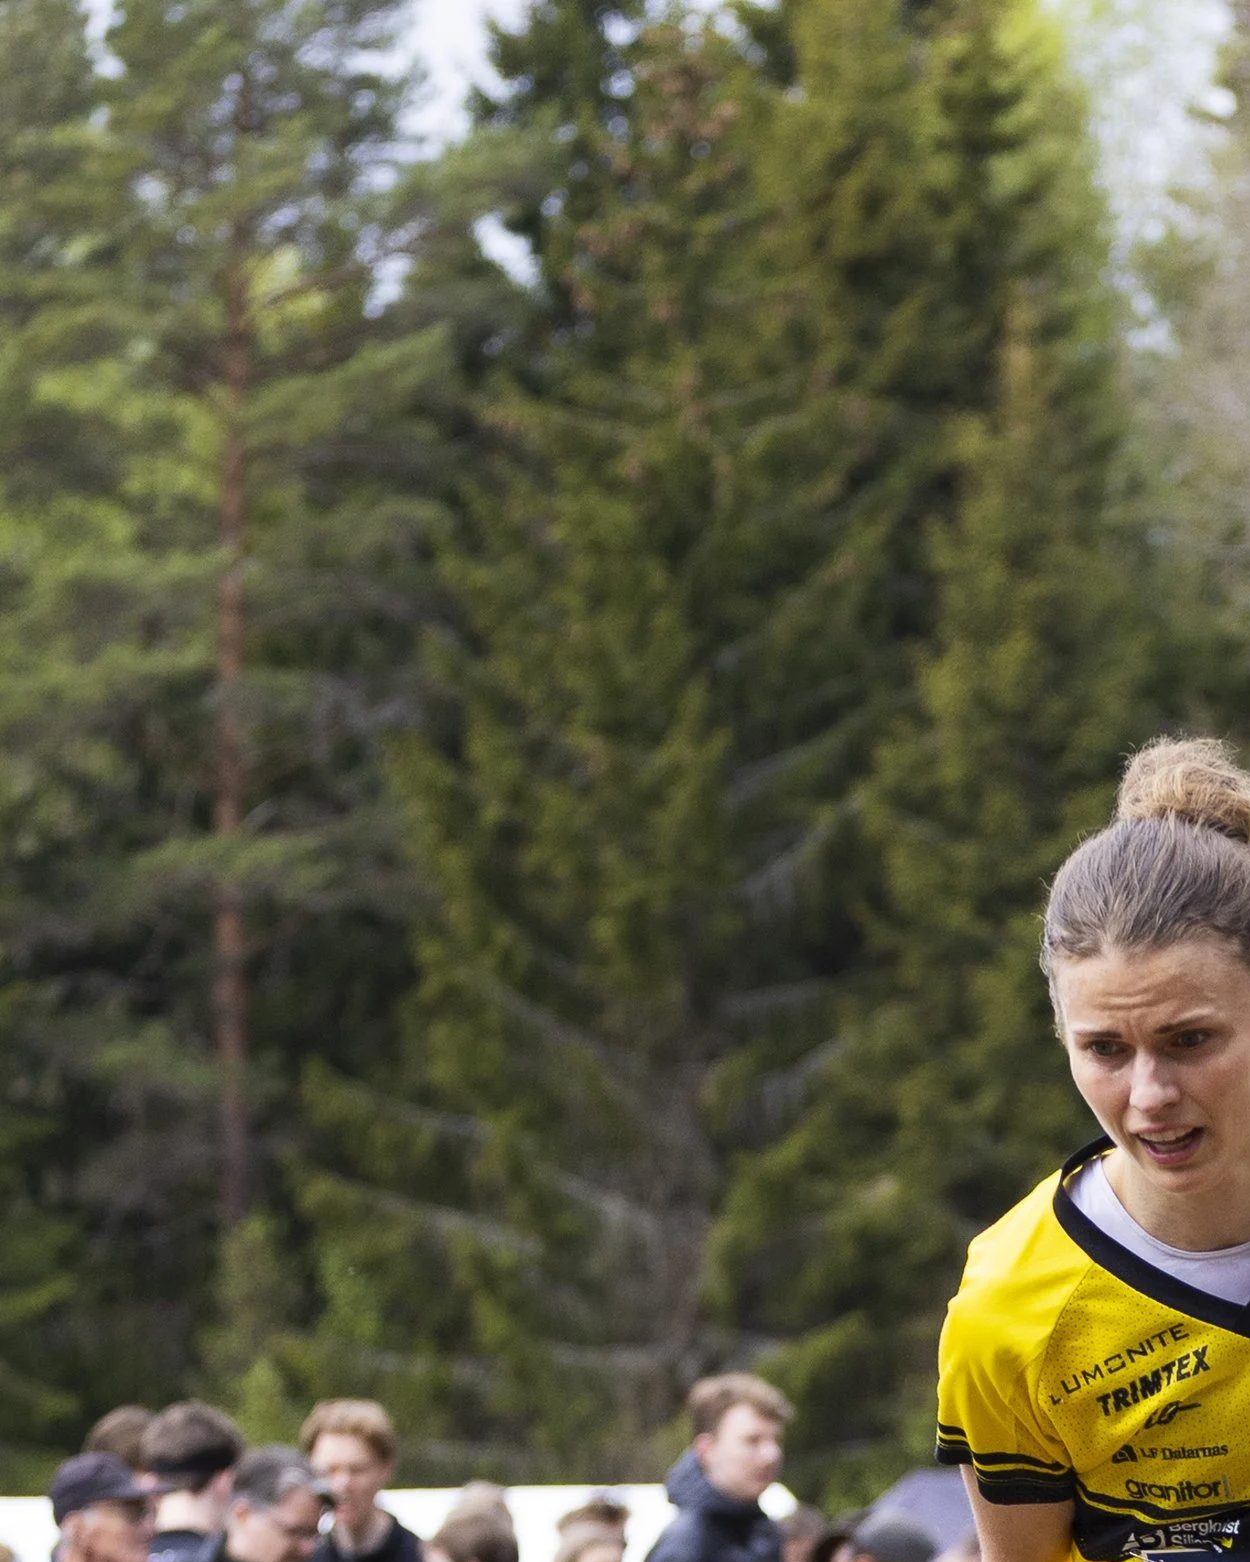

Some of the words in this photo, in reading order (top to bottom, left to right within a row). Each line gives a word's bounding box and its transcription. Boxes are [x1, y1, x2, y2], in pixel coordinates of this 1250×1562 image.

[1049, 1323, 1190, 1406] LUMONITE
[1096, 1345, 1211, 1416] TRIMTEX
[1140, 1447, 1159, 1459] LF
[1161, 1444, 1228, 1460] Dalarnas
[1125, 1478, 1222, 1502] granitor
